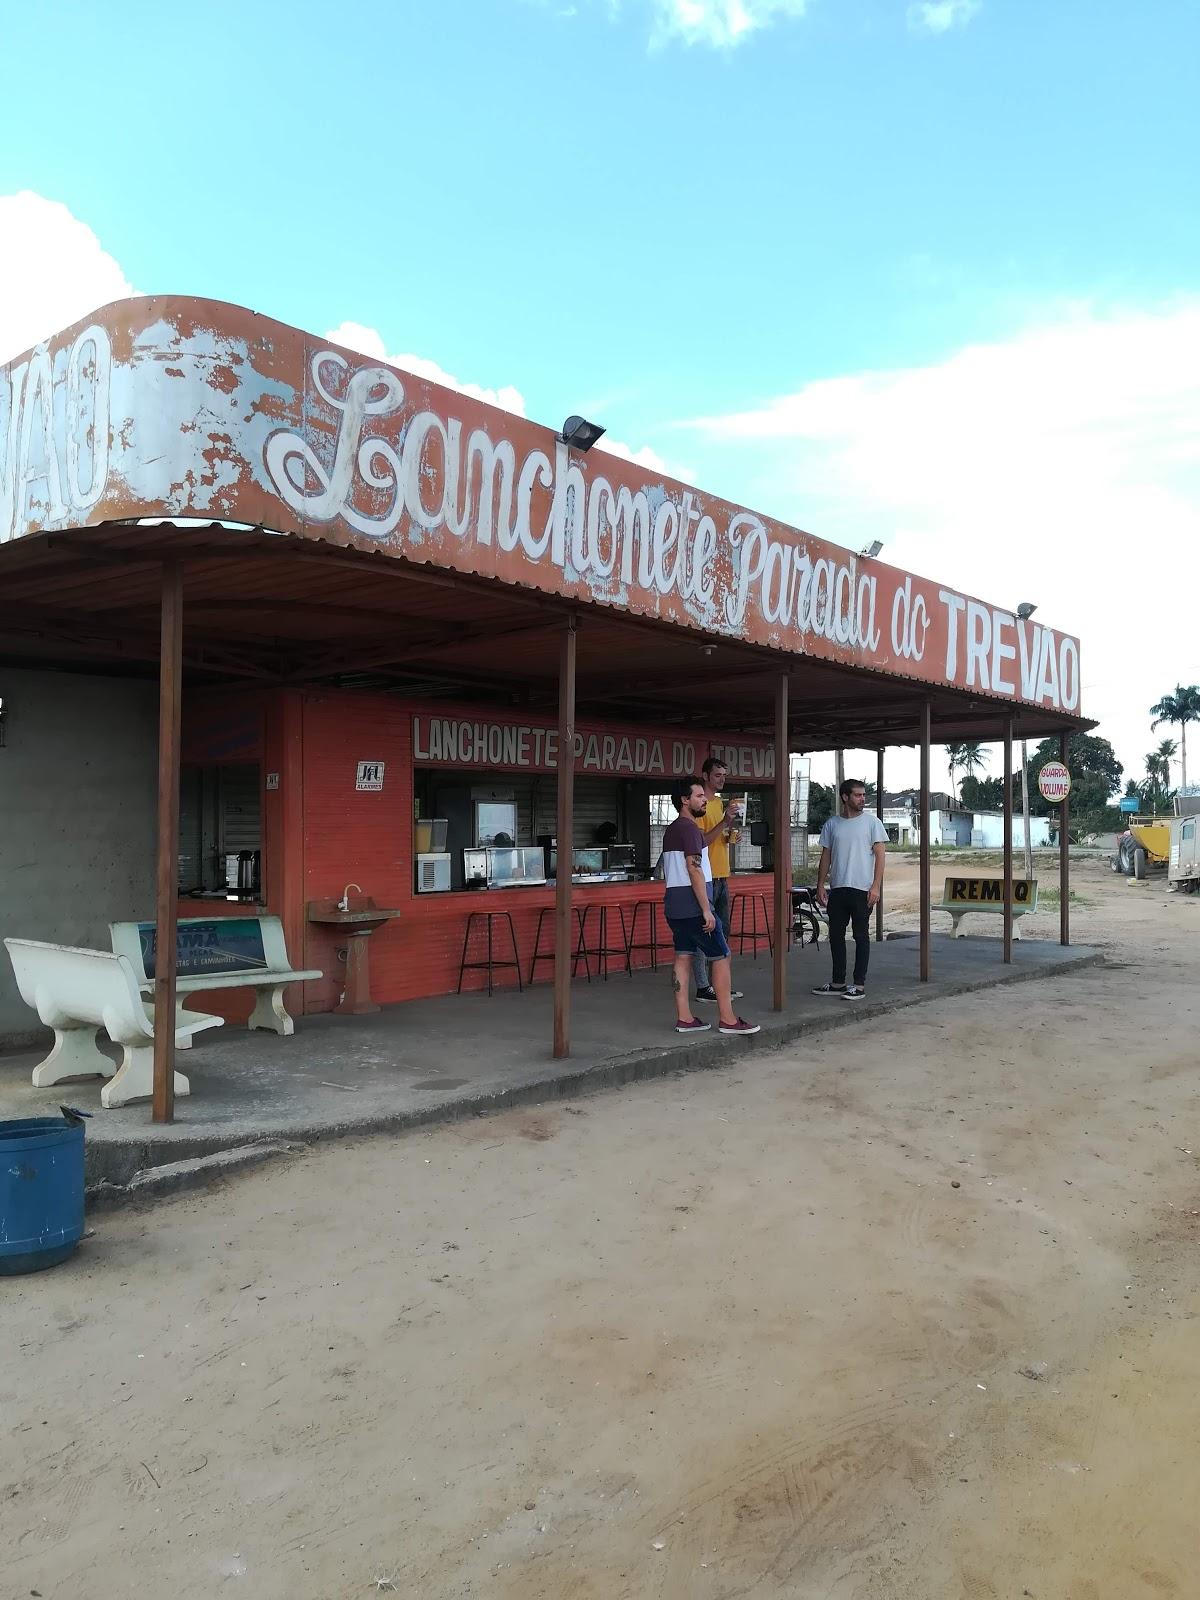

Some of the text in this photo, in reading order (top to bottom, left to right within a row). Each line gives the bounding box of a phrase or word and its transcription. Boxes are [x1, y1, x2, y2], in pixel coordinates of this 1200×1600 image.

[265, 351, 717, 602] Lanchonete
[725, 513, 881, 652] Parada
[891, 577, 930, 661] do
[413, 717, 776, 778] LANCHONETE PARADA DO TREVÃ
[1041, 768, 1068, 779] GUARDA
[1041, 783, 1068, 795] VOLUME
[952, 880, 1029, 901] REMQ
